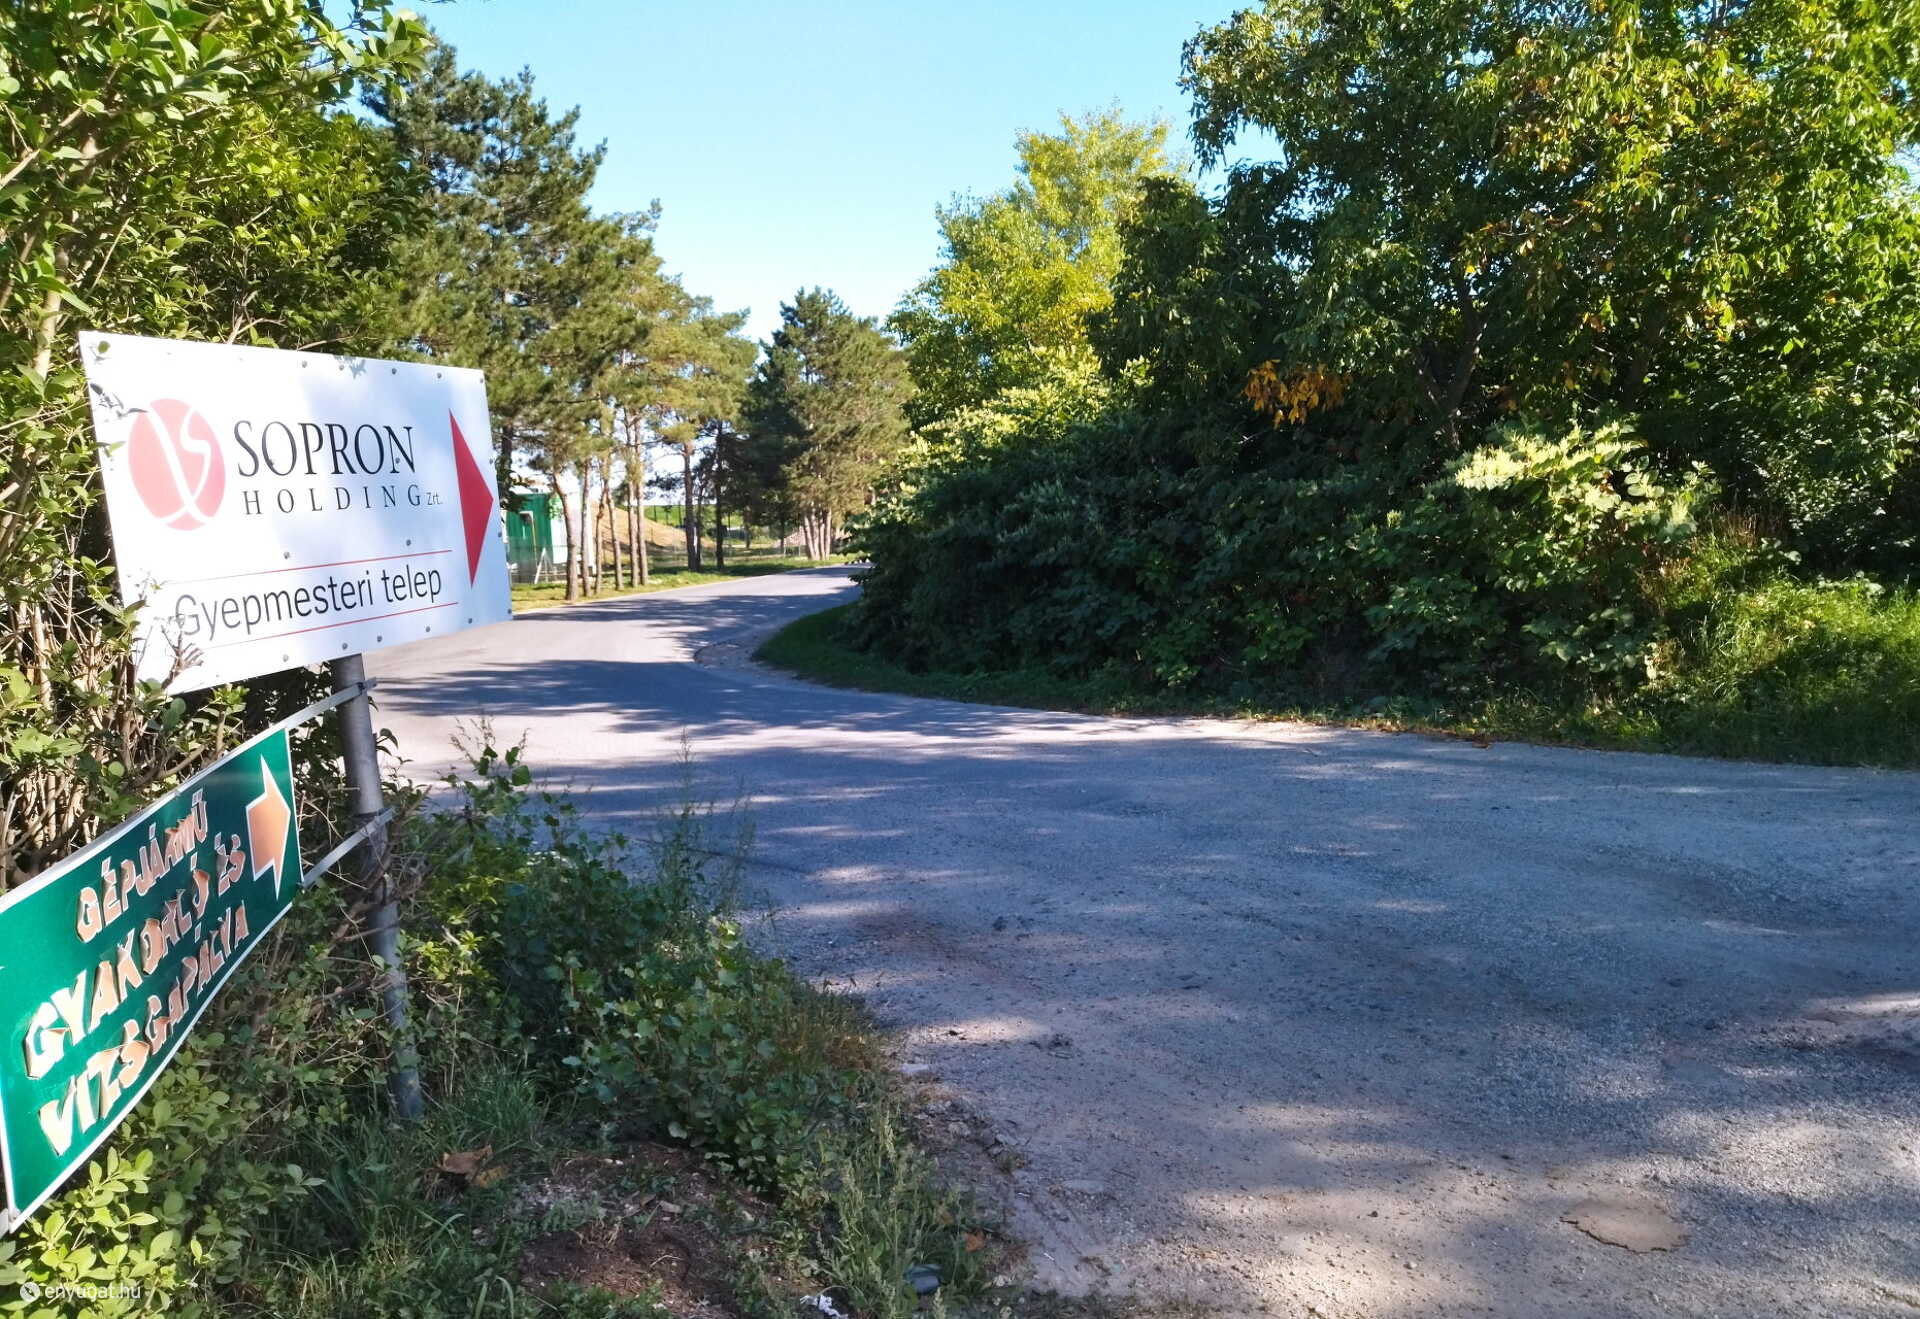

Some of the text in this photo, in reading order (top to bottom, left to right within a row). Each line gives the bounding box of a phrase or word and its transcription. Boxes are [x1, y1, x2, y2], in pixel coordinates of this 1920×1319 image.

[233, 419, 416, 477] SOPRON
[243, 484, 421, 515] HOLDING
[174, 564, 442, 641] Gyepmesteri telep
